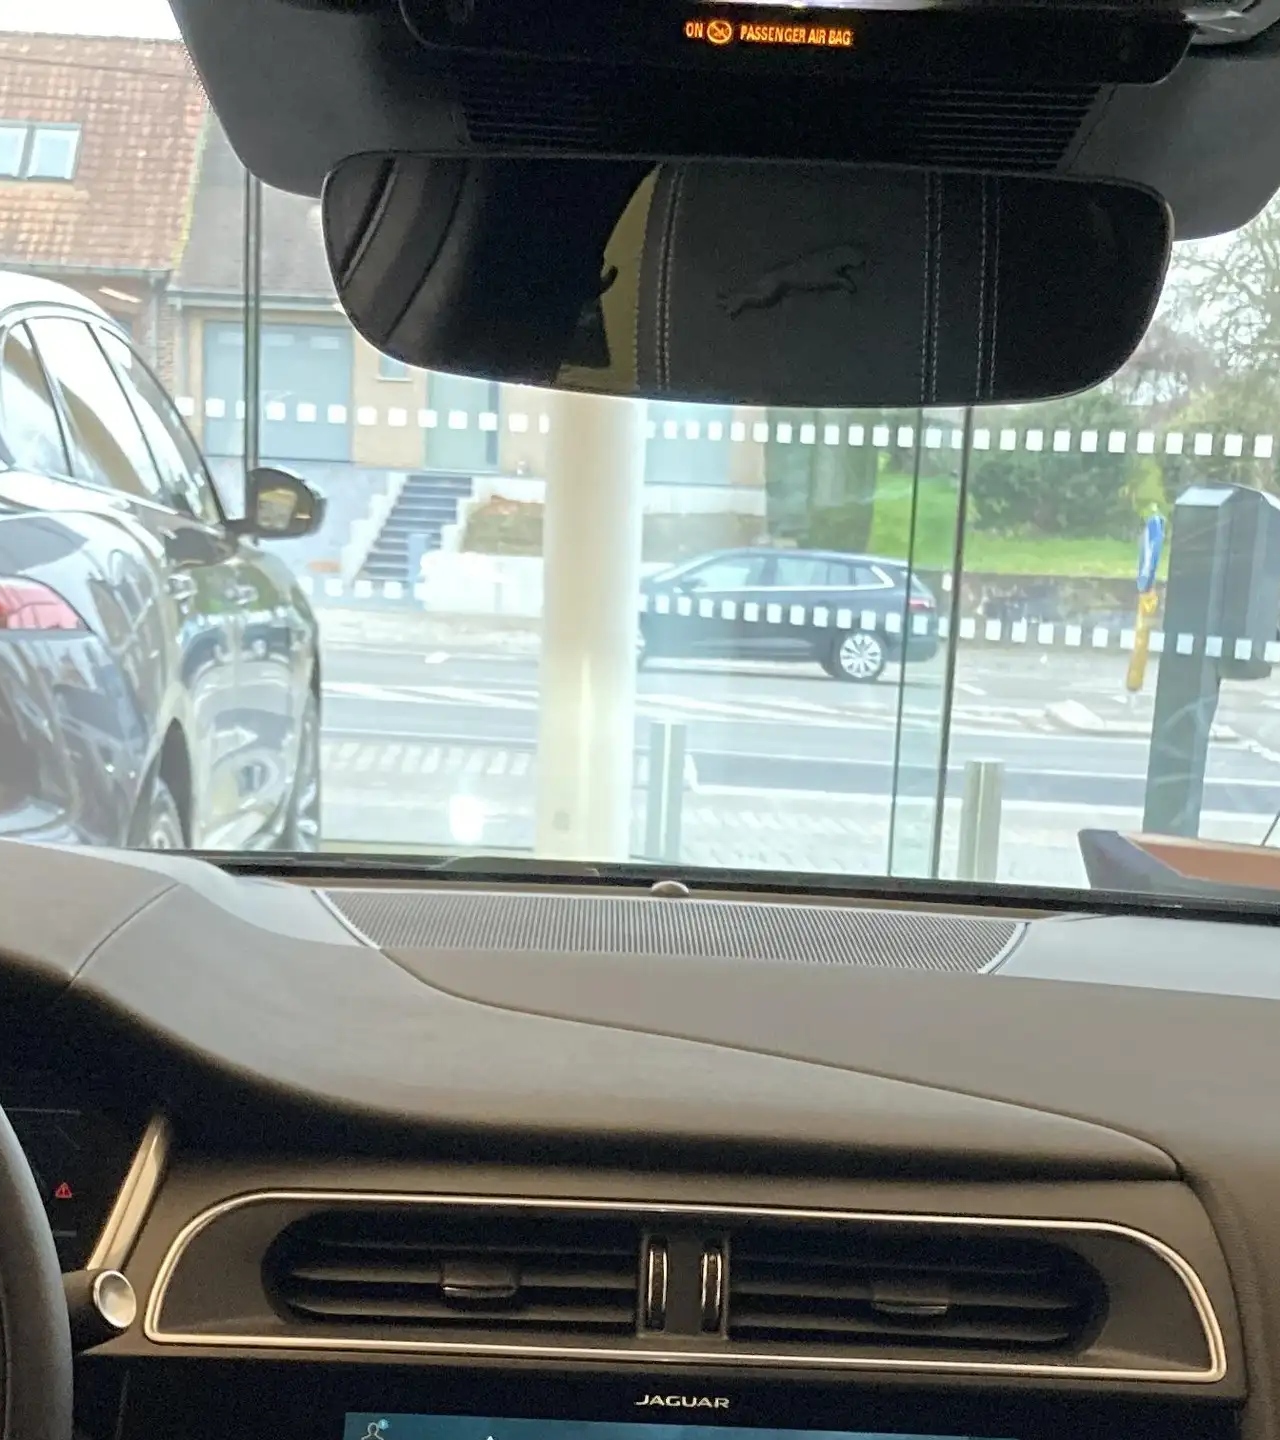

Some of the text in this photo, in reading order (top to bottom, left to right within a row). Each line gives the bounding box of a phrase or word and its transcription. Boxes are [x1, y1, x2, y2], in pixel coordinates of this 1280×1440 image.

[685, 22, 704, 38] ON
[740, 24, 852, 46] PASSENGER AIR BAG
[634, 1394, 730, 1409] JAGUAR
